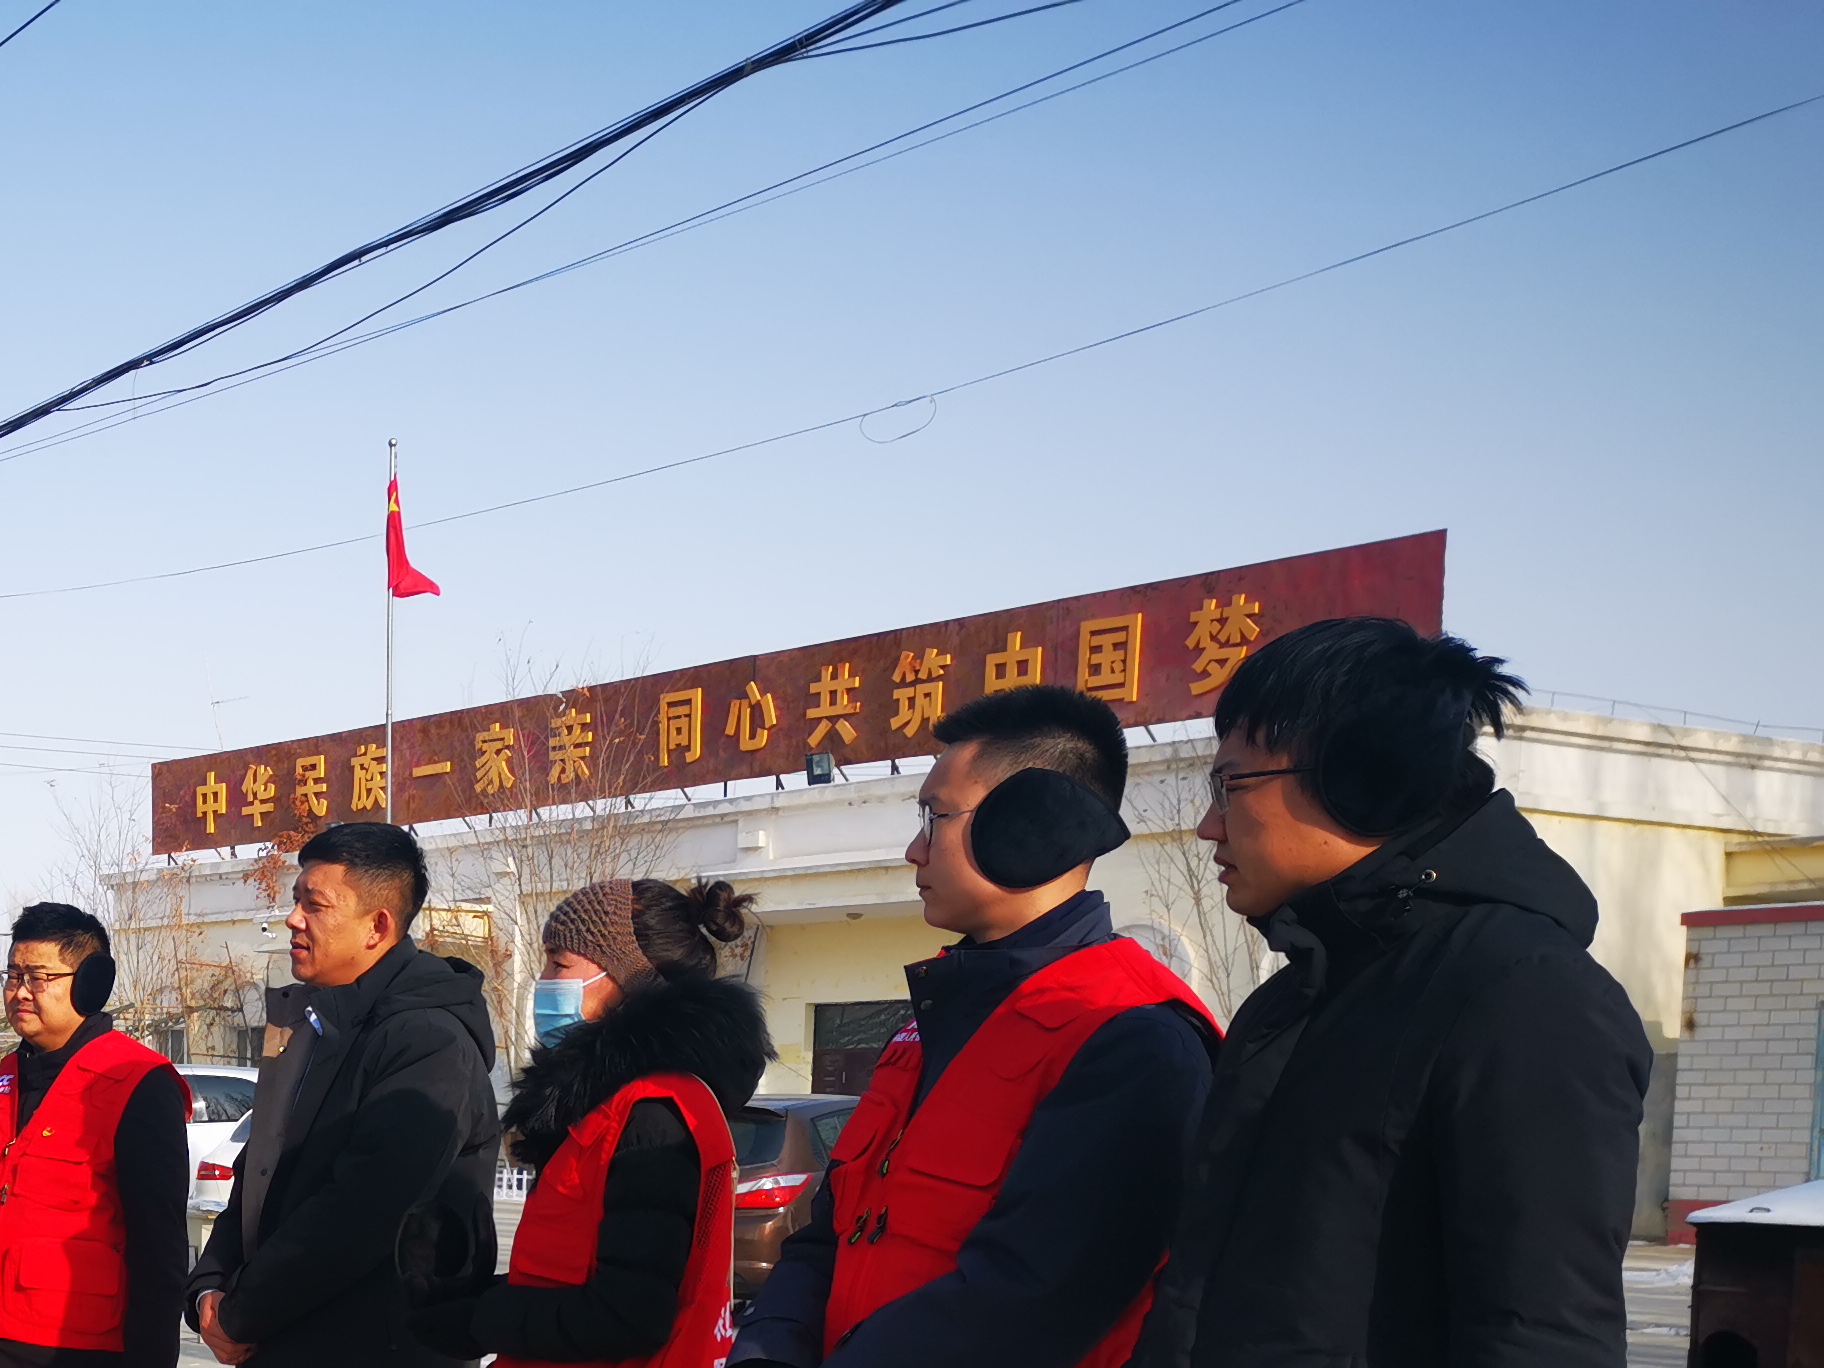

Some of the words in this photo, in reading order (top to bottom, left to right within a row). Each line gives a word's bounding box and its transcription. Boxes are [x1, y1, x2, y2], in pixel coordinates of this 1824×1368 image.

[196, 707, 594, 834] 中华民族一家亲
[659, 593, 1260, 767] 同心共筑中国梦
